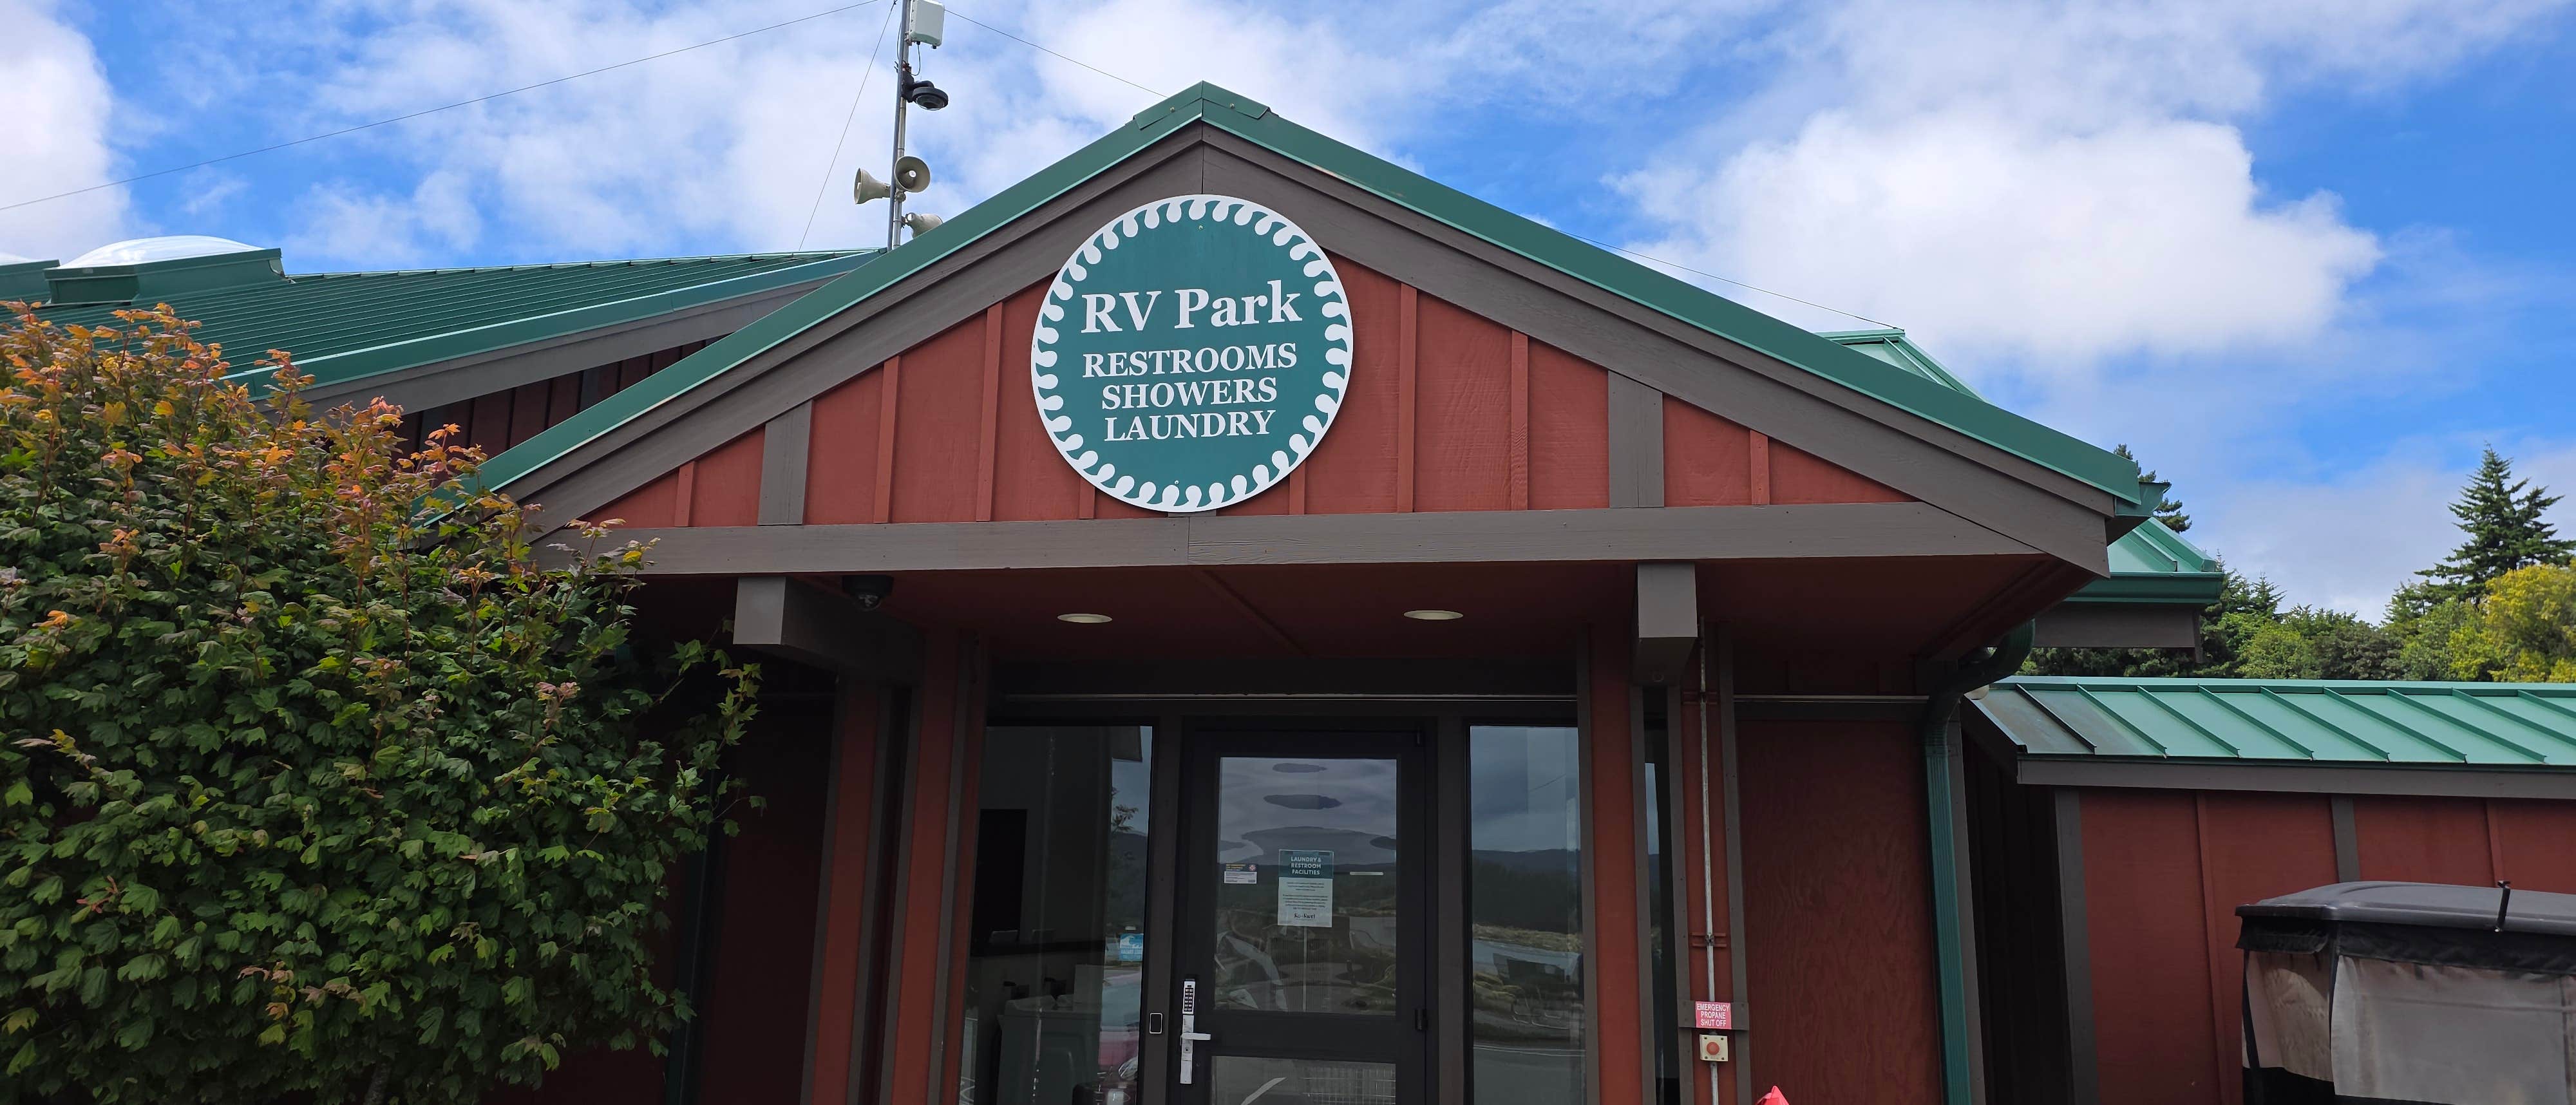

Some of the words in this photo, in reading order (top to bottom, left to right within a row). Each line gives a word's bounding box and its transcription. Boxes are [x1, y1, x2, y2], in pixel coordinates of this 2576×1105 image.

[1081, 290, 1161, 334] RV
[1174, 279, 1302, 329] Park
[1083, 343, 1297, 378] RESTROOMS
[1102, 377, 1277, 410] SHOWERS
[1104, 410, 1276, 442] LAUNDRY
[1696, 1003, 1730, 1012] EMERGENCY
